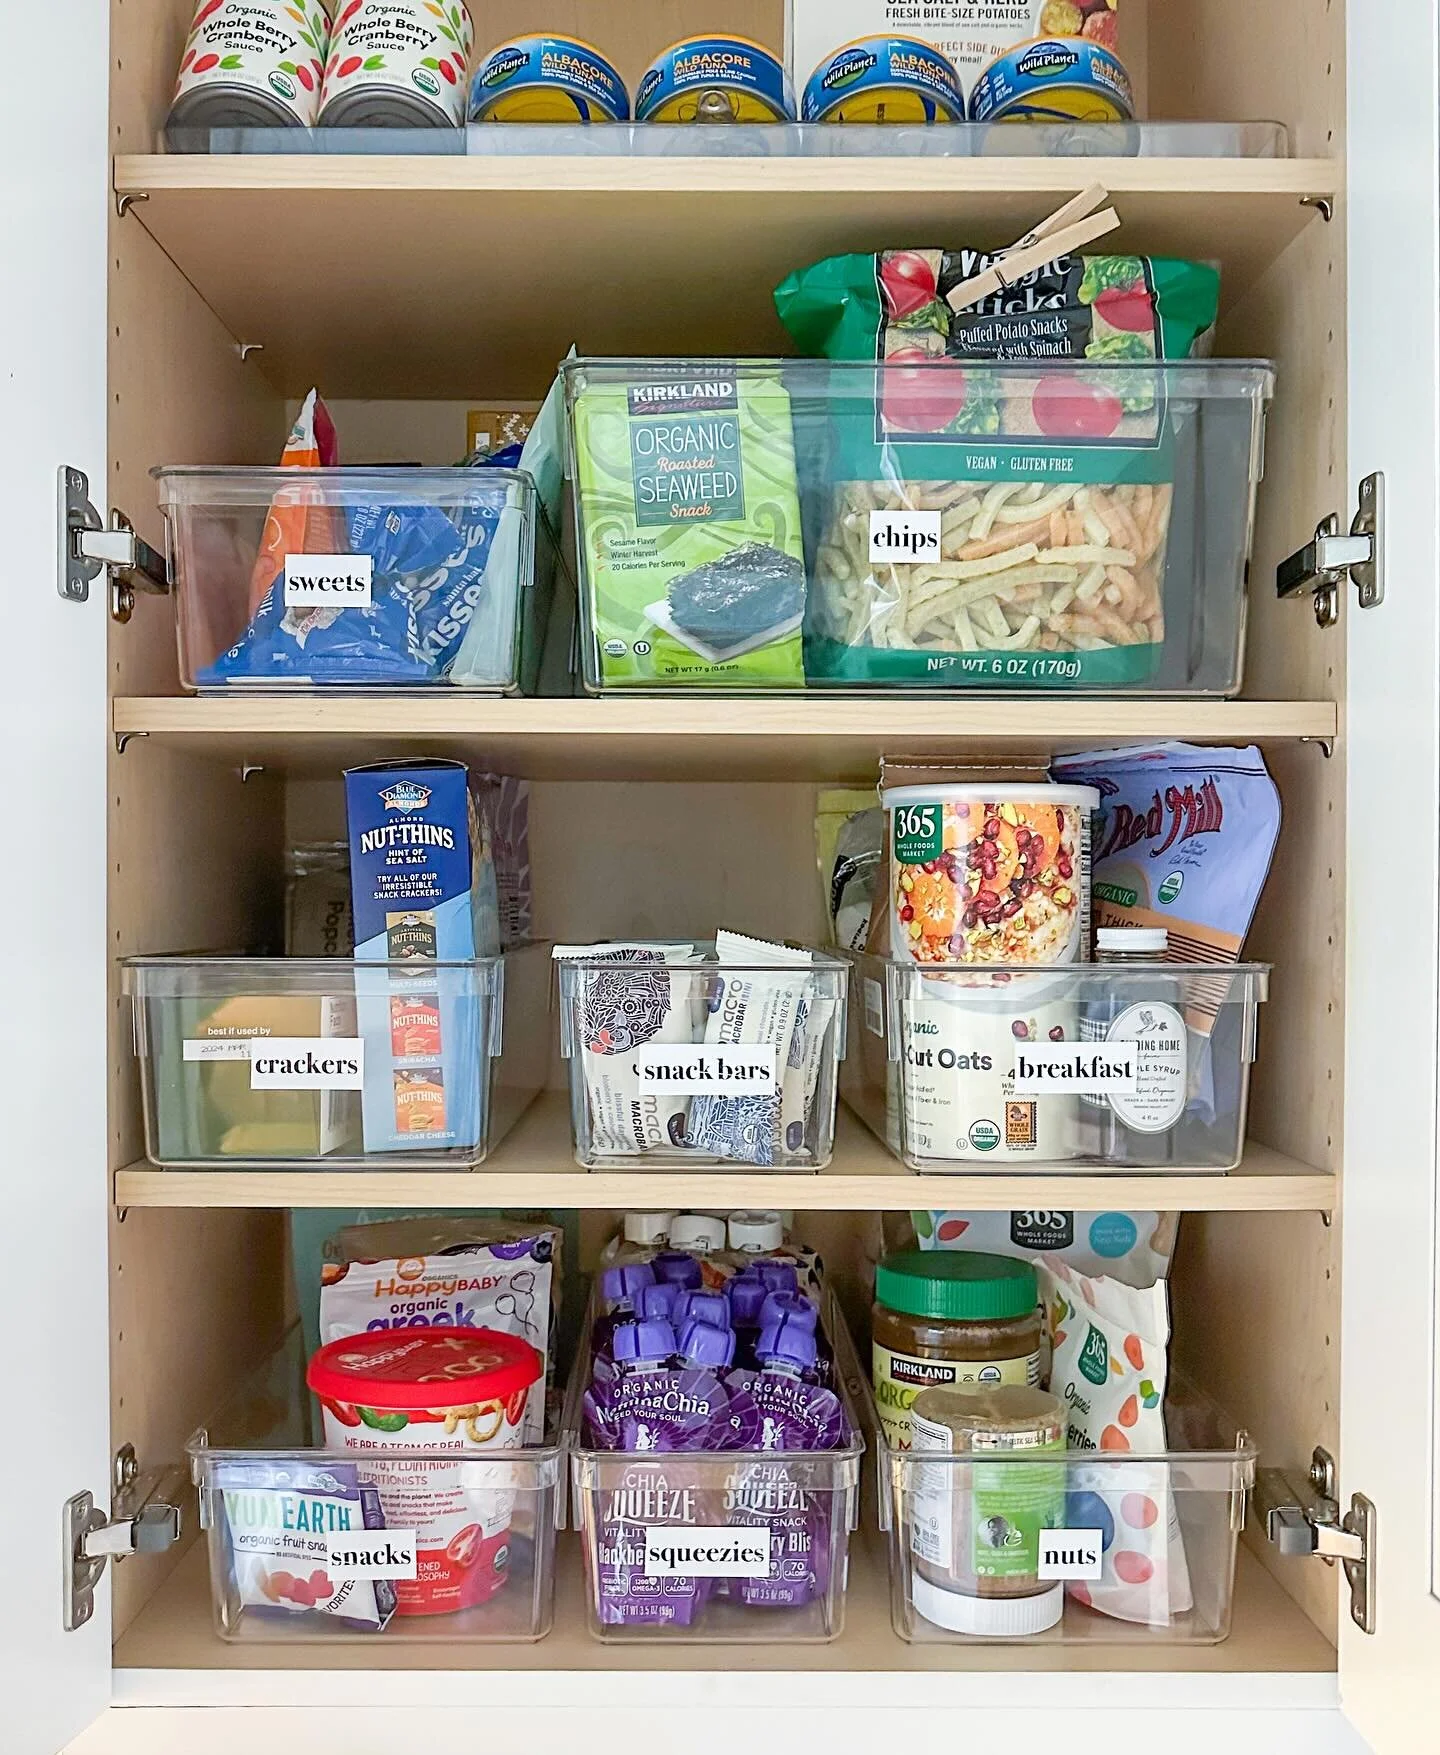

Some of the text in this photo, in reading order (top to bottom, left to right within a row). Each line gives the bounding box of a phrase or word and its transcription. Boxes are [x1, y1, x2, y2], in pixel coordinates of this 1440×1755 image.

[226, 4, 277, 20] Organic
[365, 4, 416, 16] Organic
[886, 8, 1031, 20] FRESH BITE-SIZE POTATOES
[203, 18, 297, 47] Whole Berry
[344, 17, 437, 42] Whole Berry
[206, 30, 287, 54] Cranberry
[348, 29, 429, 50] Cranberry
[932, 41, 986, 52] RFECT SIDE
[541, 52, 614, 88] ALBACORE
[674, 53, 752, 71] ALBACORE
[674, 62, 728, 77] WILD TUNA
[890, 60, 915, 71] WILD
[1019, 57, 1042, 72] Wild
[481, 67, 498, 86] Wild
[541, 61, 594, 81] WILD TUNA
[823, 69, 841, 88] Wild
[960, 316, 1068, 344] Puffed Potato Snacks
[1006, 336, 1072, 356] with Spinach
[633, 382, 733, 402] KIRKLAND
[635, 422, 736, 455] ORGANIC
[657, 454, 715, 472] Roasted
[965, 456, 1074, 472] VEGAN GLUTEN FREE
[639, 471, 737, 503] SEAWEED
[669, 502, 712, 518] Snack
[610, 538, 657, 547] Sesame Flavor
[873, 525, 938, 554] chips
[610, 550, 658, 559] Winter Harvest
[622, 562, 647, 570] Calories
[661, 560, 686, 569] Serving
[289, 574, 365, 592] sweets
[927, 657, 1082, 678] NET WT. 6 OZ (170g)
[386, 791, 426, 800] DIAMOND
[389, 816, 424, 824] ALMOND
[897, 805, 935, 839] 365
[1093, 774, 1223, 862] Red Mill
[361, 823, 454, 854] NUT-THINS
[385, 855, 427, 865] SEA SALT
[388, 848, 424, 857] HINT OF
[377, 872, 438, 883] TRY ALL OF OUR
[382, 881, 433, 891] IRRESISTIBLE
[373, 889, 443, 899] SNACK CRACKERS!
[391, 932, 432, 945] NUT-THINS
[393, 1014, 439, 1029] NUT-THINS
[731, 1002, 747, 1044] ACROBAR
[207, 1026, 271, 1037] best if used by
[1158, 1040, 1180, 1051] HOME
[255, 1052, 358, 1075] crackers
[938, 1048, 992, 1071] Oats
[1018, 1055, 1134, 1079] breakfast
[644, 1058, 770, 1081] snack bars
[1153, 1065, 1180, 1076] SYRUP
[397, 1090, 443, 1105] NUT-THINS
[1043, 1231, 1066, 1239] FOODS
[373, 1275, 502, 1298] HappyBABY
[390, 1298, 448, 1315] organic
[893, 1360, 953, 1380] KIRKLAND
[614, 1380, 680, 1398] ORGANIC
[742, 1382, 808, 1405] ORGANIC
[1065, 1382, 1091, 1415] Organic
[614, 1410, 632, 1420] EED
[633, 1409, 657, 1420] YOUR
[762, 1403, 785, 1414] YOUR
[345, 1436, 358, 1448] WE
[1068, 1424, 1097, 1450] erries
[627, 1474, 668, 1489] CHIA
[753, 1467, 789, 1480] CHIA
[727, 1515, 807, 1527] VITALITY SNACK
[604, 1527, 647, 1538] VITALITY
[240, 1535, 328, 1552] organic fruit sna
[789, 1532, 811, 1552] Blis
[331, 1544, 411, 1566] snacks
[599, 1543, 644, 1566] lackbe
[650, 1541, 765, 1568] squeezies
[1044, 1548, 1096, 1565] nuts
[792, 1562, 804, 1570] 70
[417, 1571, 450, 1581] OSOPHY
[673, 1577, 686, 1585] 70
[323, 1580, 357, 1613] VORITE
